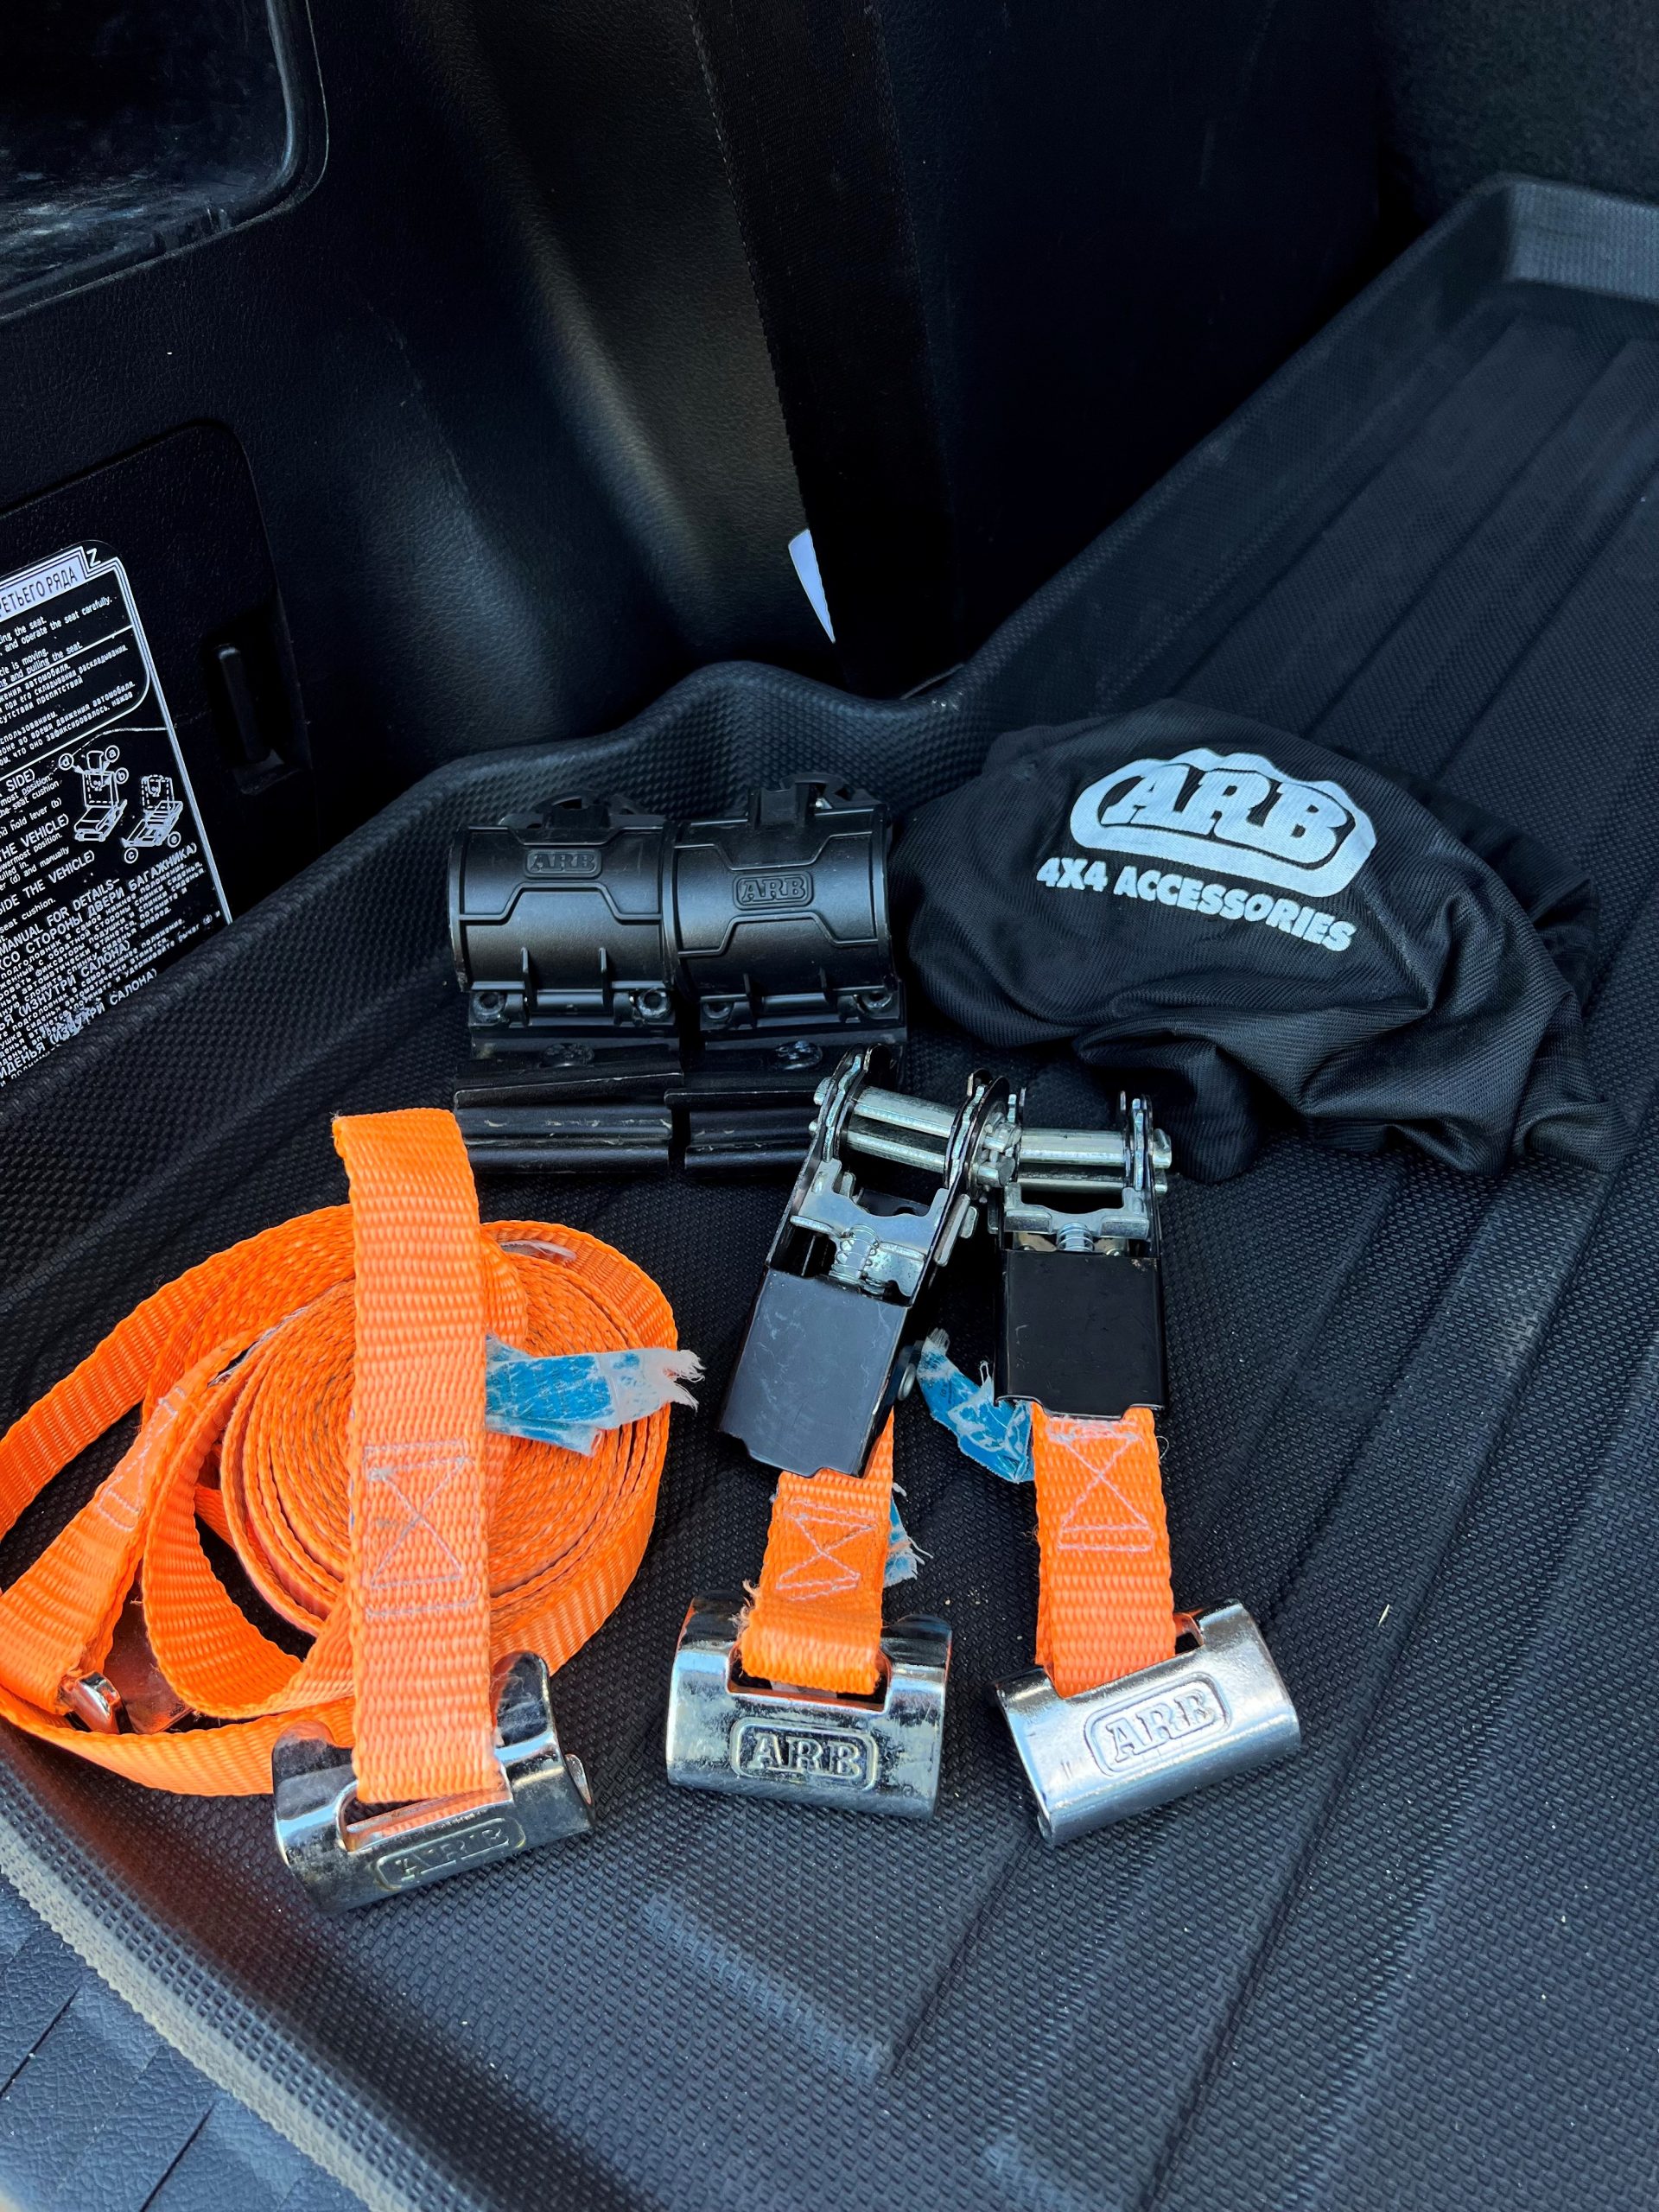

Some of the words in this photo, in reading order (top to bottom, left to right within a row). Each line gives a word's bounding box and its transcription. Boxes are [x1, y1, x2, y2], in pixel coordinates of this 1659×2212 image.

[0, 581, 45, 613] ЕТЬЕГО
[46, 566, 78, 594] РЯДА
[5, 639, 19, 652] and
[21, 626, 48, 644] operate
[49, 620, 61, 630] the
[64, 610, 79, 624] seat
[81, 596, 112, 615] carefully.
[14, 626, 27, 636] the
[29, 616, 47, 630] seat.
[10, 669, 24, 682] and
[26, 658, 51, 677] pulling
[52, 651, 64, 661] the
[66, 641, 83, 654] seat.
[22, 648, 48, 665] moving.
[6, 768, 35, 791] SIDE)
[13, 796, 29, 810] seat
[32, 781, 59, 799] cushion
[29, 806, 47, 820] lever
[51, 798, 61, 809] (b)
[1101, 763, 1348, 865] ARB
[20, 813, 69, 847] VEHICLE)
[33, 833, 62, 853] position.
[10, 874, 21, 884] (d)
[23, 864, 37, 877] and
[40, 847, 69, 868] manually
[22, 879, 46, 898] THE
[48, 850, 94, 883] VEHICLE)
[530, 853, 596, 873] ARB
[741, 876, 806, 903] ARB
[1037, 857, 1109, 892] 4X4
[1114, 866, 1357, 951] ACCESSORIES
[22, 898, 56, 920] cushion.
[26, 912, 83, 954] СТОРОНЫ
[87, 887, 124, 918] ДВЕРИ
[47, 906, 70, 926] FOR
[19, 974, 76, 1017] (ИЗНУТРИ
[80, 940, 130, 977] САЛОНА)
[1105, 1688, 1216, 1763] ARB
[747, 1732, 861, 1779] ARB
